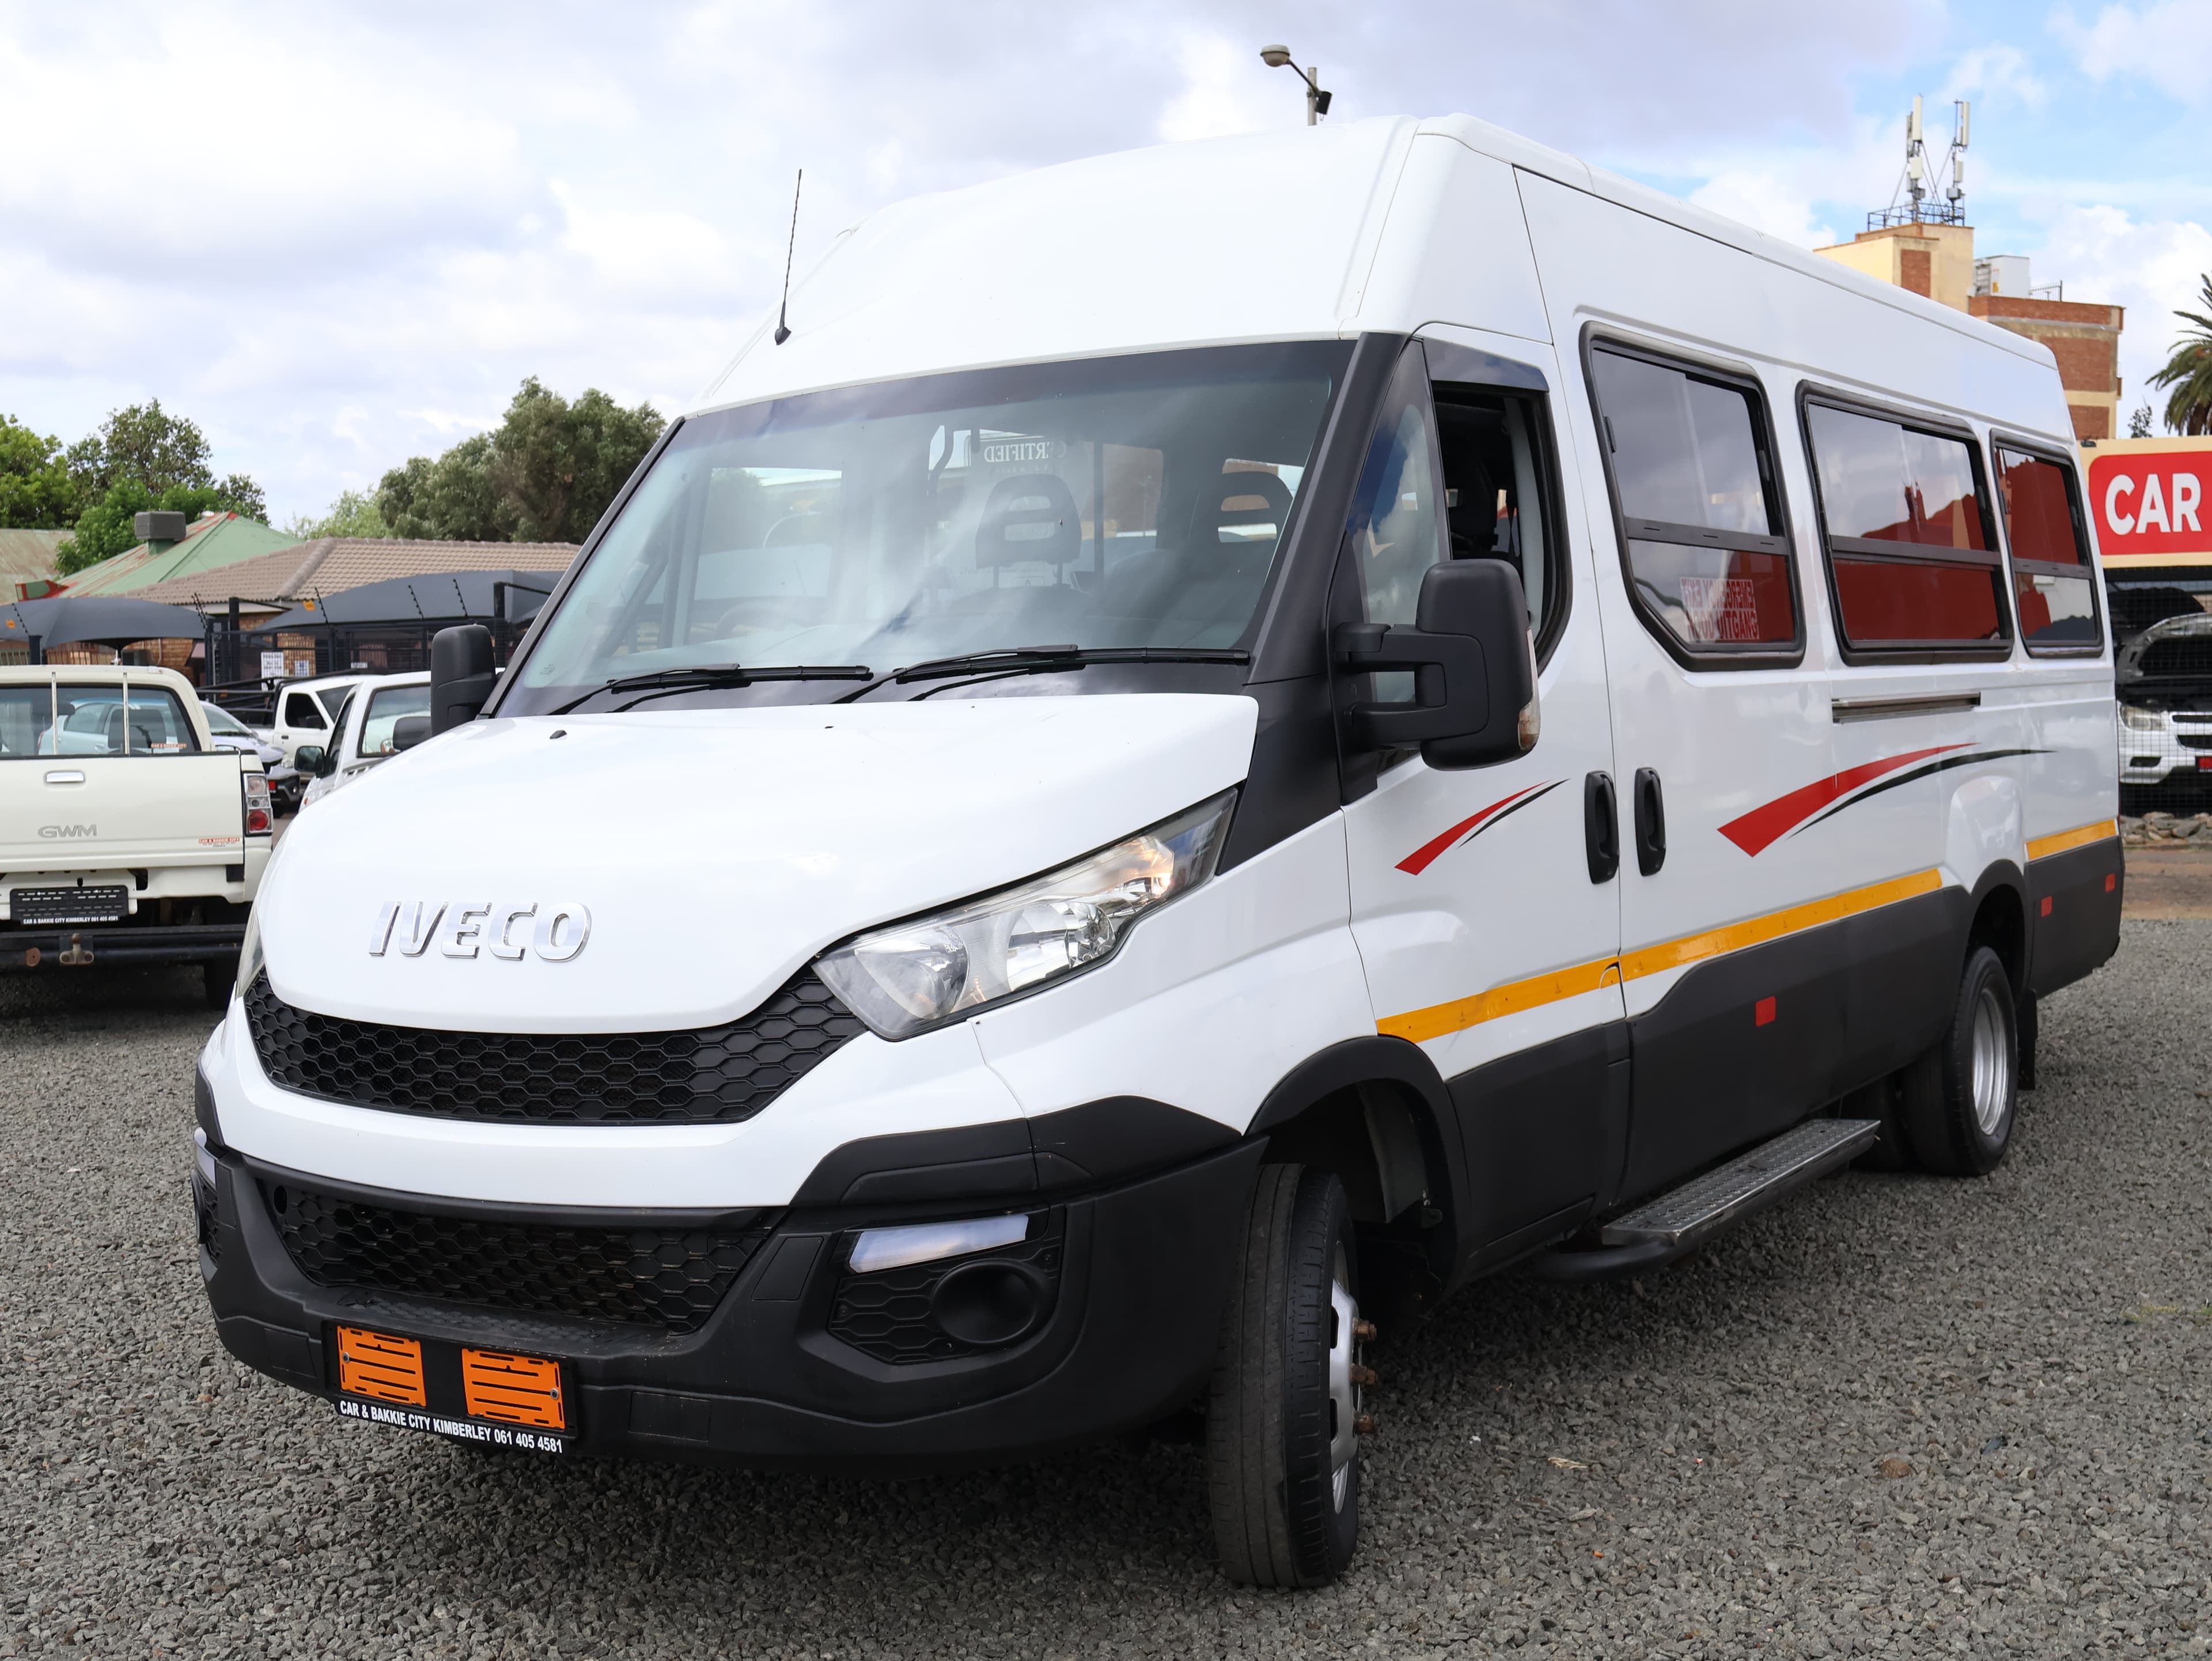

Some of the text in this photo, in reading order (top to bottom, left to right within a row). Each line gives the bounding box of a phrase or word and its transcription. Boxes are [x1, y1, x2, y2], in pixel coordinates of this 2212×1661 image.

[2105, 472, 2203, 536] CAR
[37, 824, 97, 838] GWM
[368, 901, 592, 962] IVECO
[340, 1401, 563, 1453] CAR & BAKKIE CITY KIMBERLEY 061 405 4581
